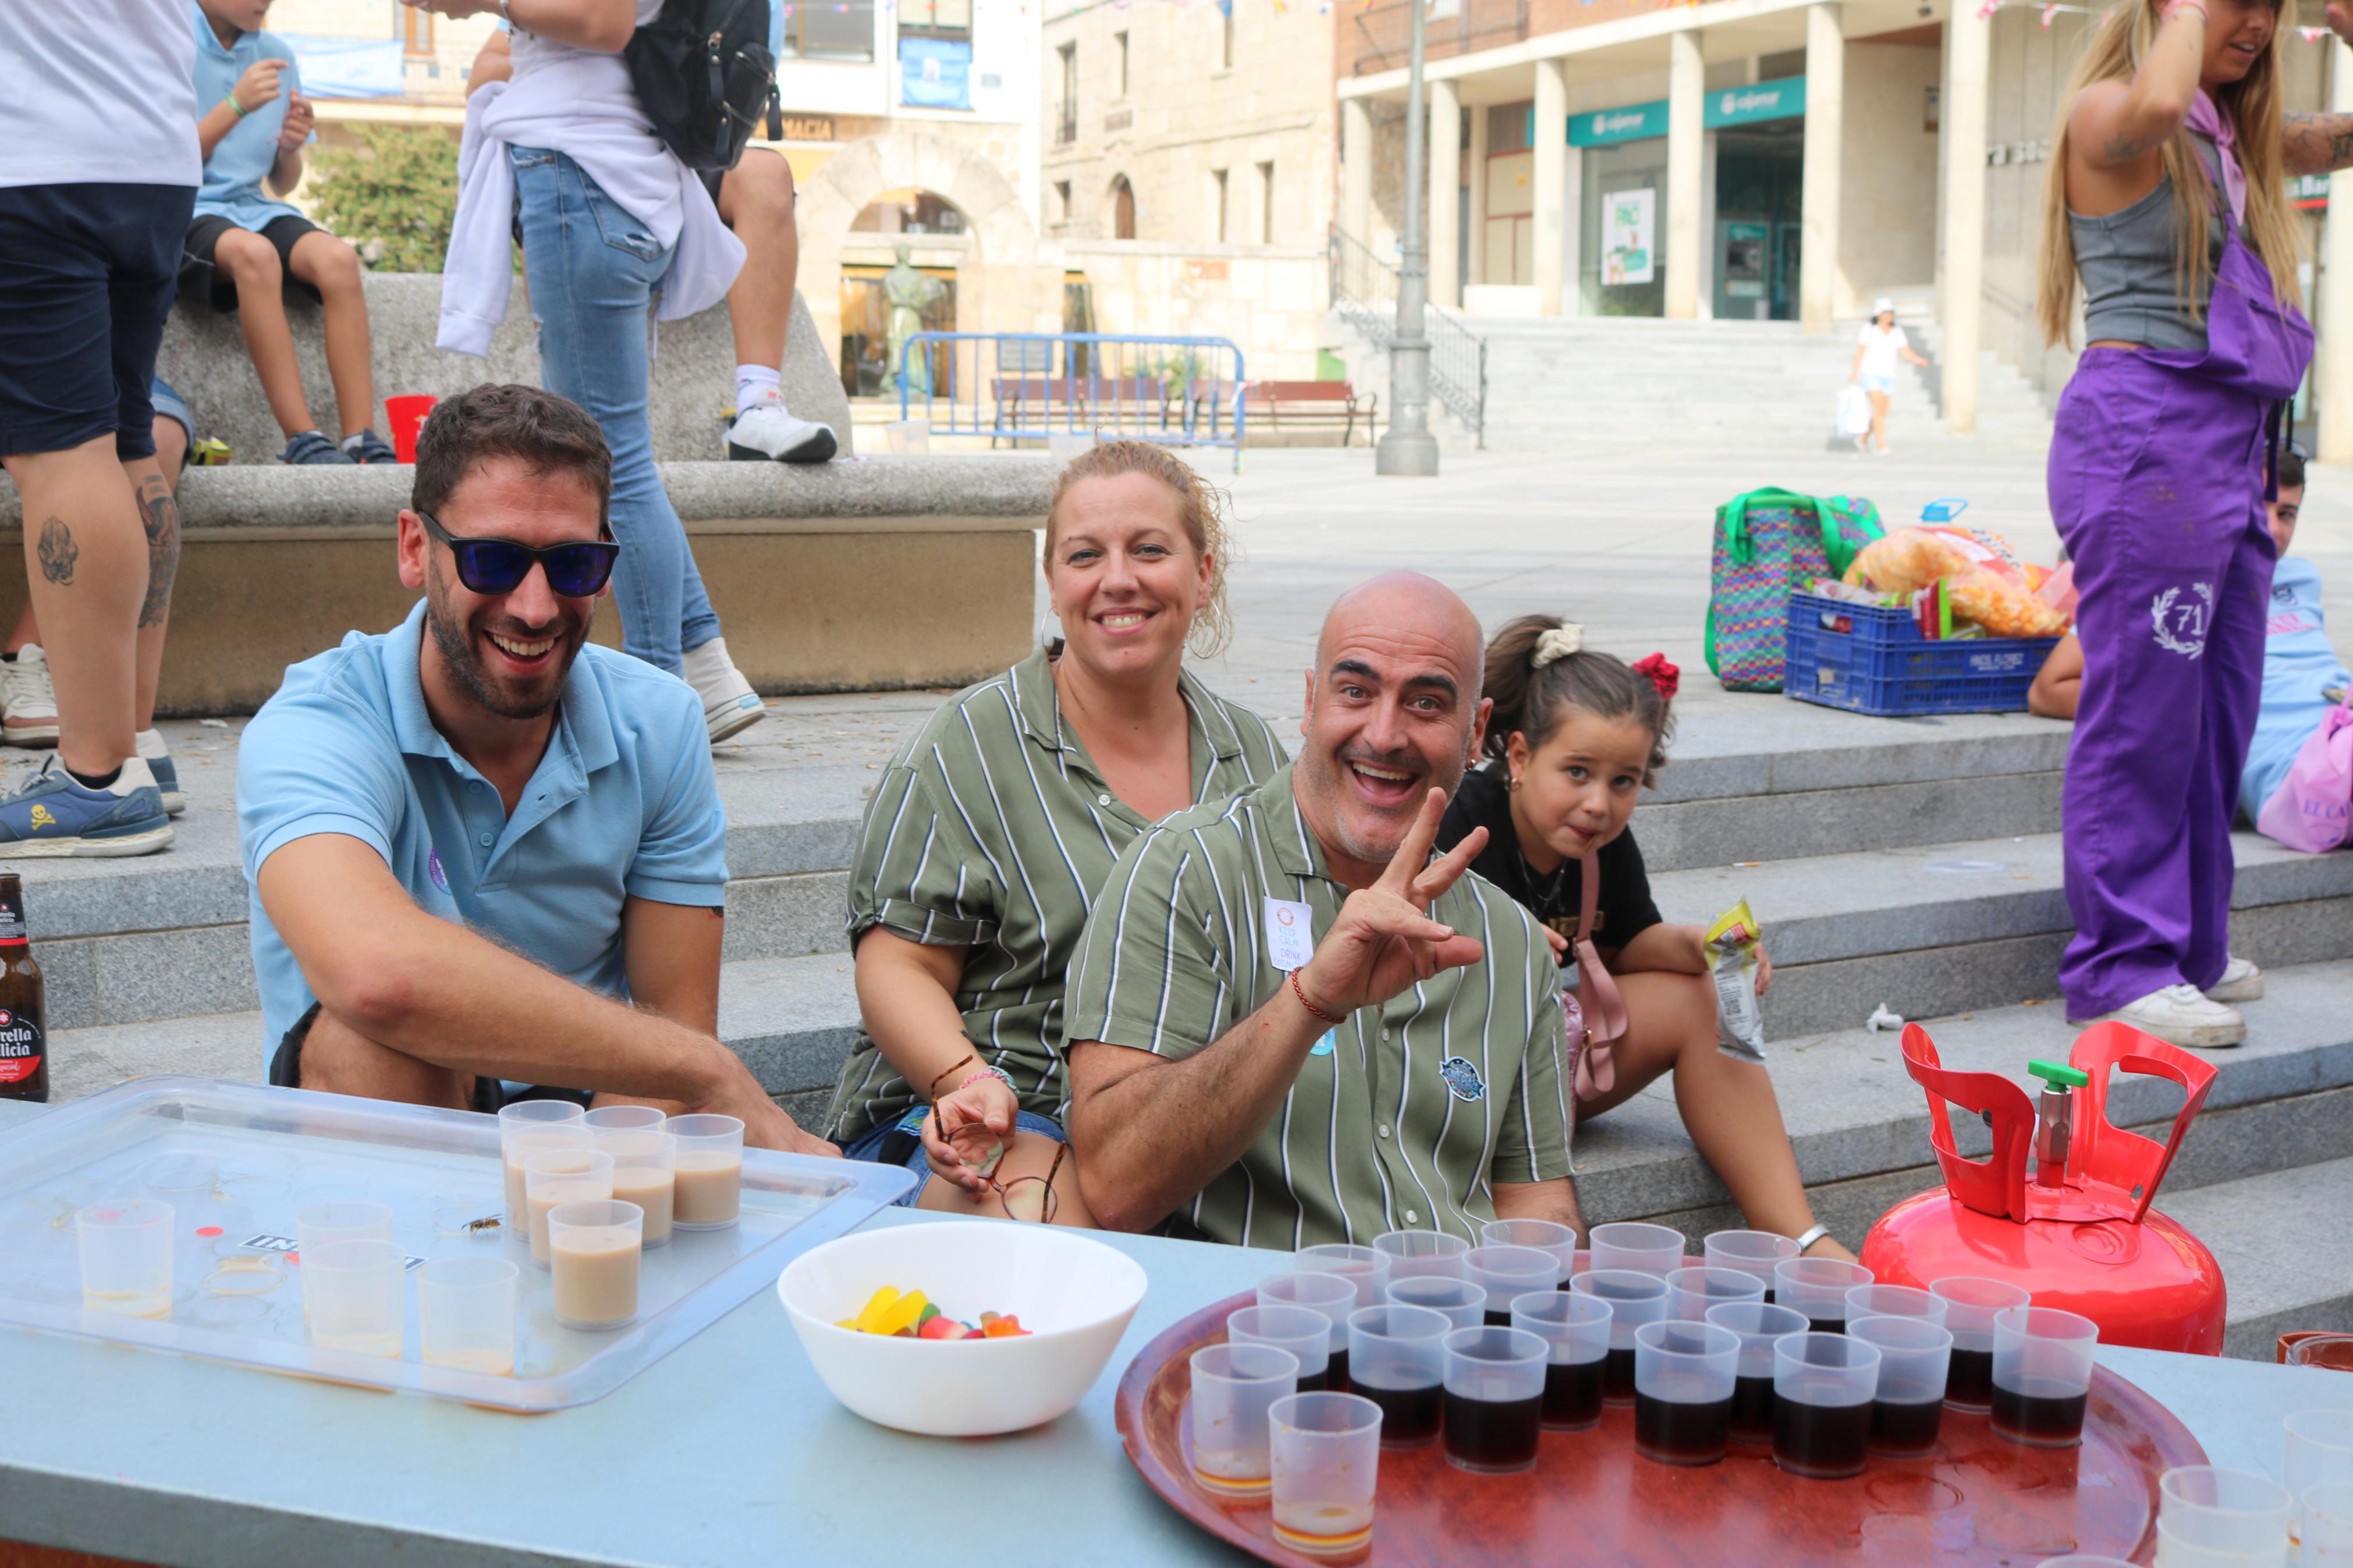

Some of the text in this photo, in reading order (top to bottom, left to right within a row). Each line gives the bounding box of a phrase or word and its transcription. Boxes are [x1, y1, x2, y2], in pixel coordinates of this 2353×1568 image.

[2174, 604, 2203, 636] 71
[1279, 925, 1296, 937] KEEP
[1279, 935, 1301, 948] CALM
[1280, 948, 1302, 962] DRINK
[0, 1027, 32, 1043] rella
[0, 1042, 31, 1057] licia
